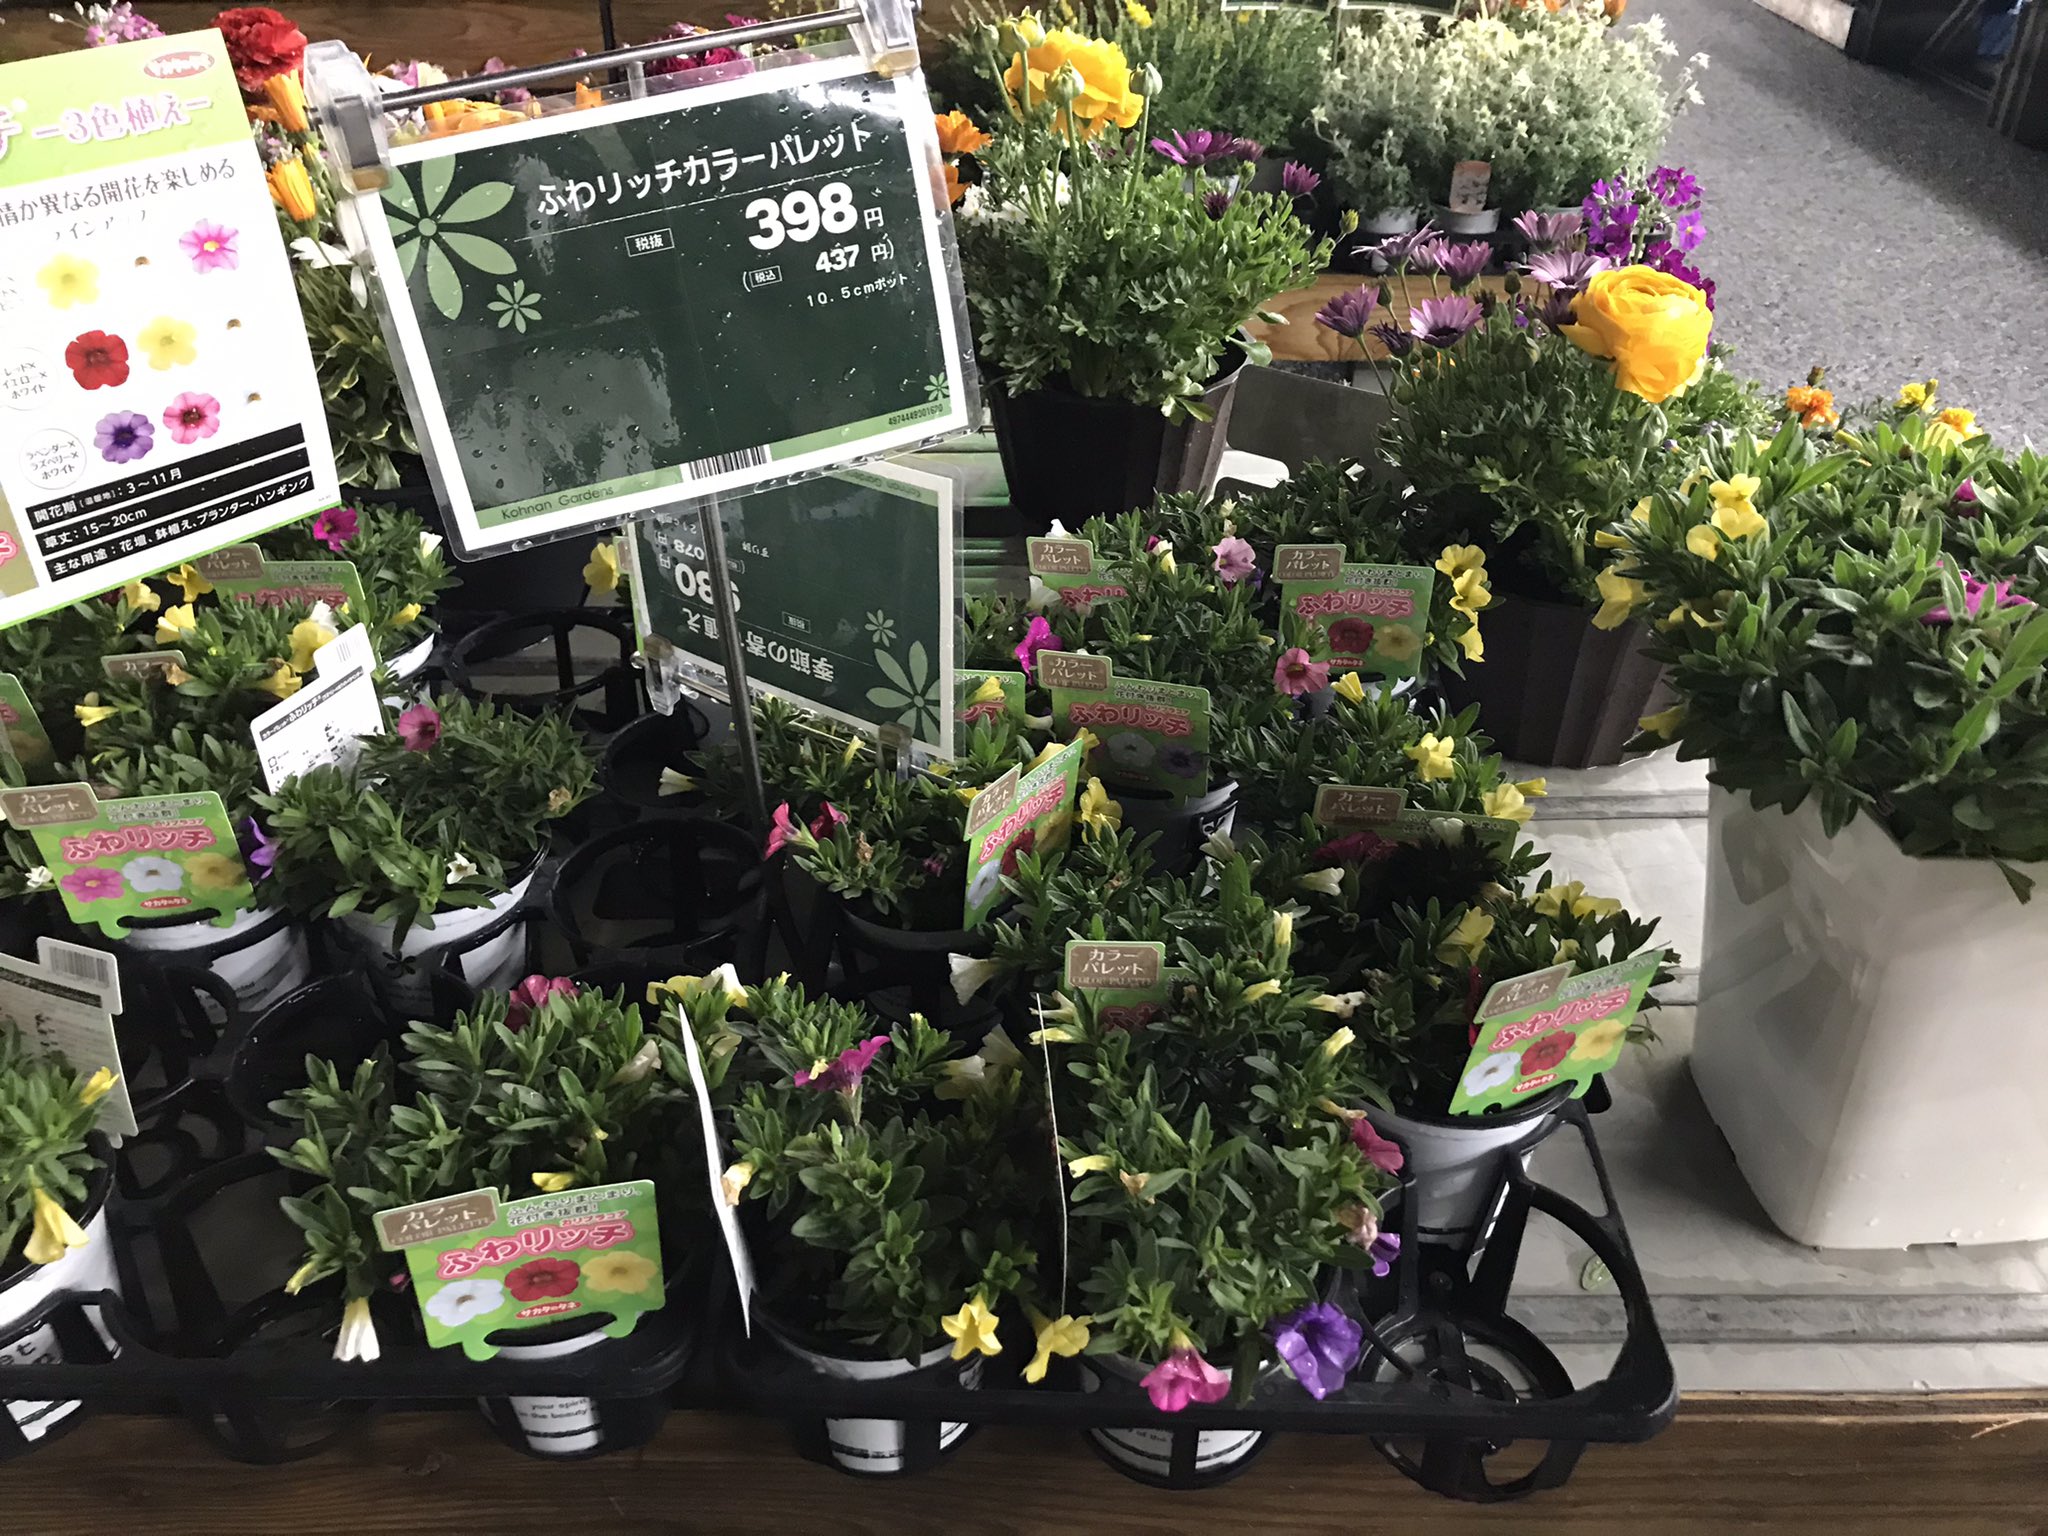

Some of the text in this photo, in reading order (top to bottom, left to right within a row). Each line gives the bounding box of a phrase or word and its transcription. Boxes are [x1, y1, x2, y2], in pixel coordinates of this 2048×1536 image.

[744, 182, 859, 251] 398
[864, 206, 884, 230] 円
[815, 245, 860, 275] 437
[501, 486, 614, 520] Kohnan Gardens
[1043, 543, 1077, 554] カラー
[1293, 550, 1329, 559] カラー
[1040, 553, 1081, 565] パレット
[1286, 560, 1330, 570] パレット
[1055, 657, 1093, 668] カラー
[1050, 667, 1097, 681] パレット
[1089, 948, 1139, 961] カラー
[1081, 962, 1144, 975] パレット
[401, 1209, 477, 1233] パレット
[439, 1221, 634, 1278] ふわリッチ
